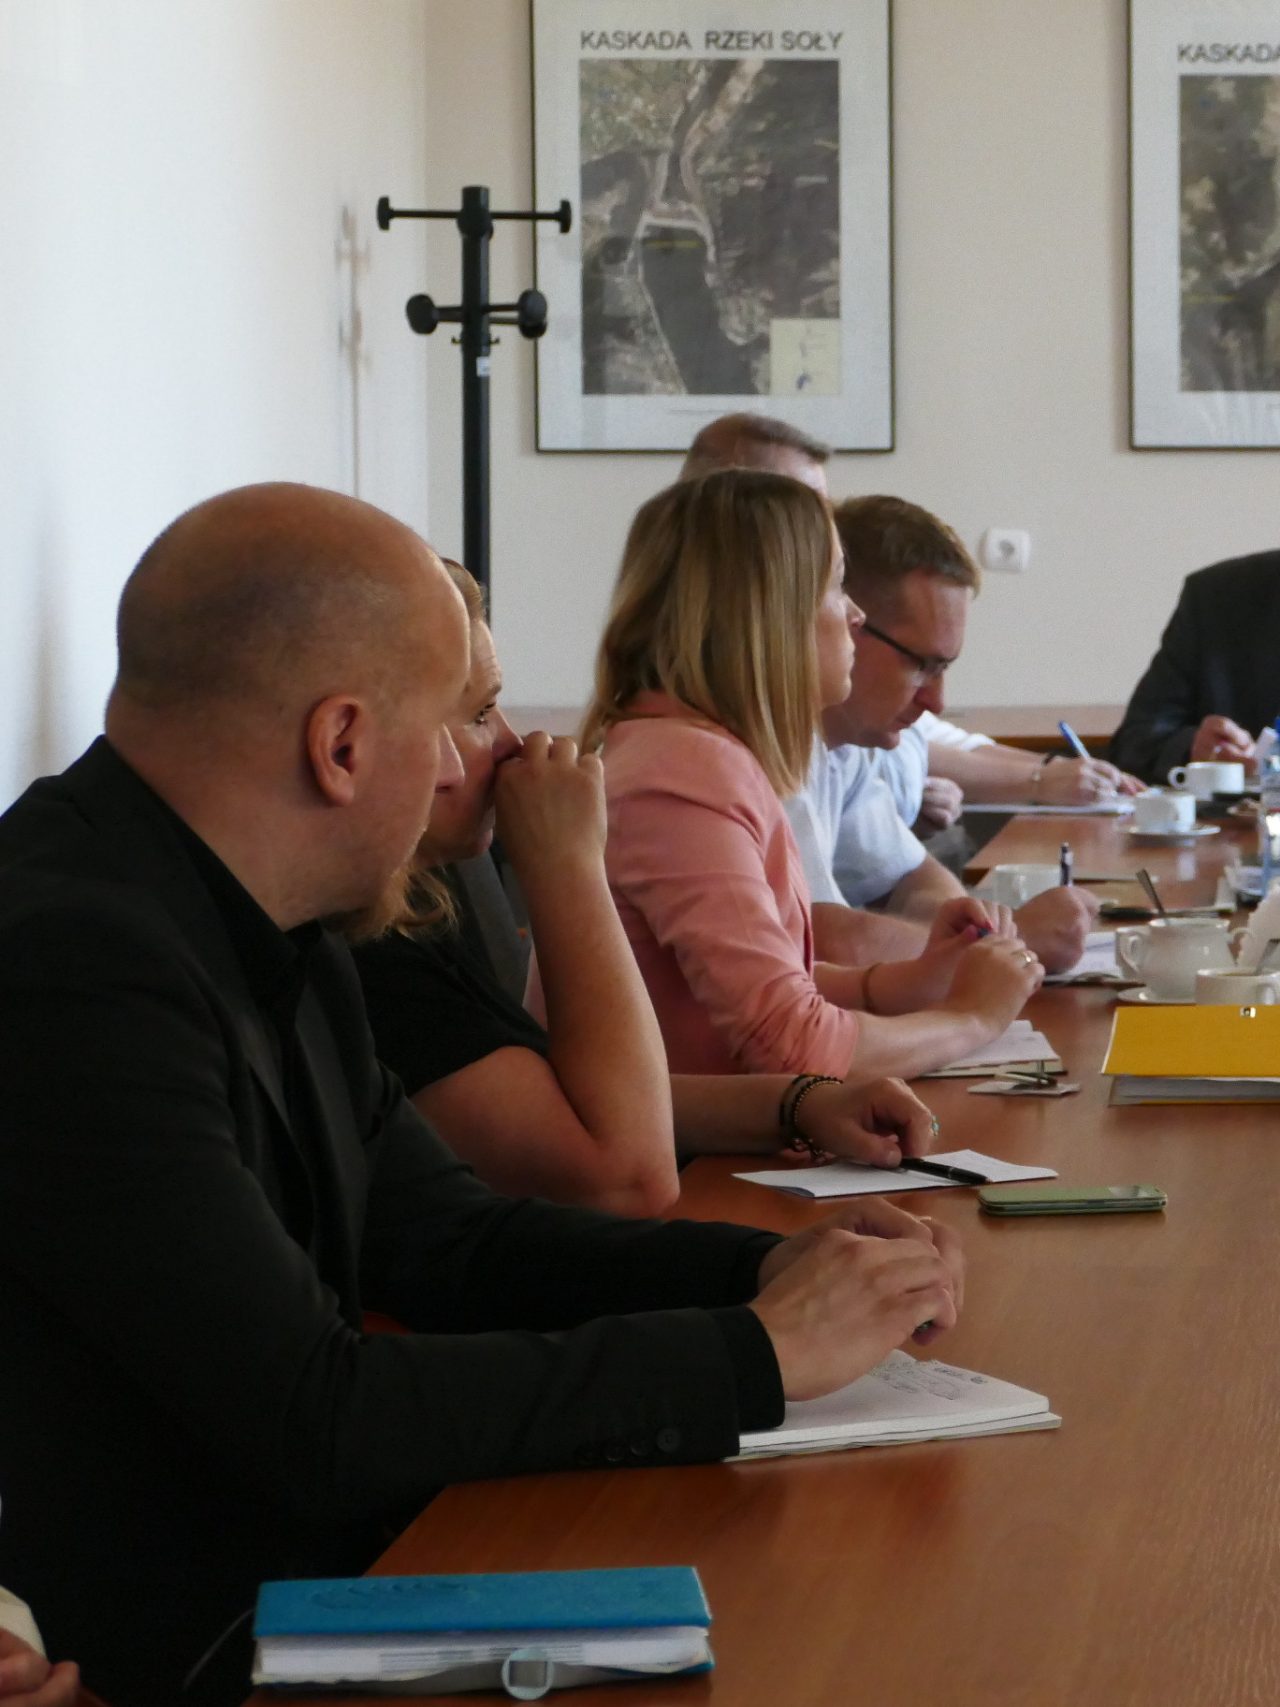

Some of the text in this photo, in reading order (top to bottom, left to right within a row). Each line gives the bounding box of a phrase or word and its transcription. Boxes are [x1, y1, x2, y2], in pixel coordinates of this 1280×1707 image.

[580, 30, 843, 51] KASKADA RZEKI SOŁY
